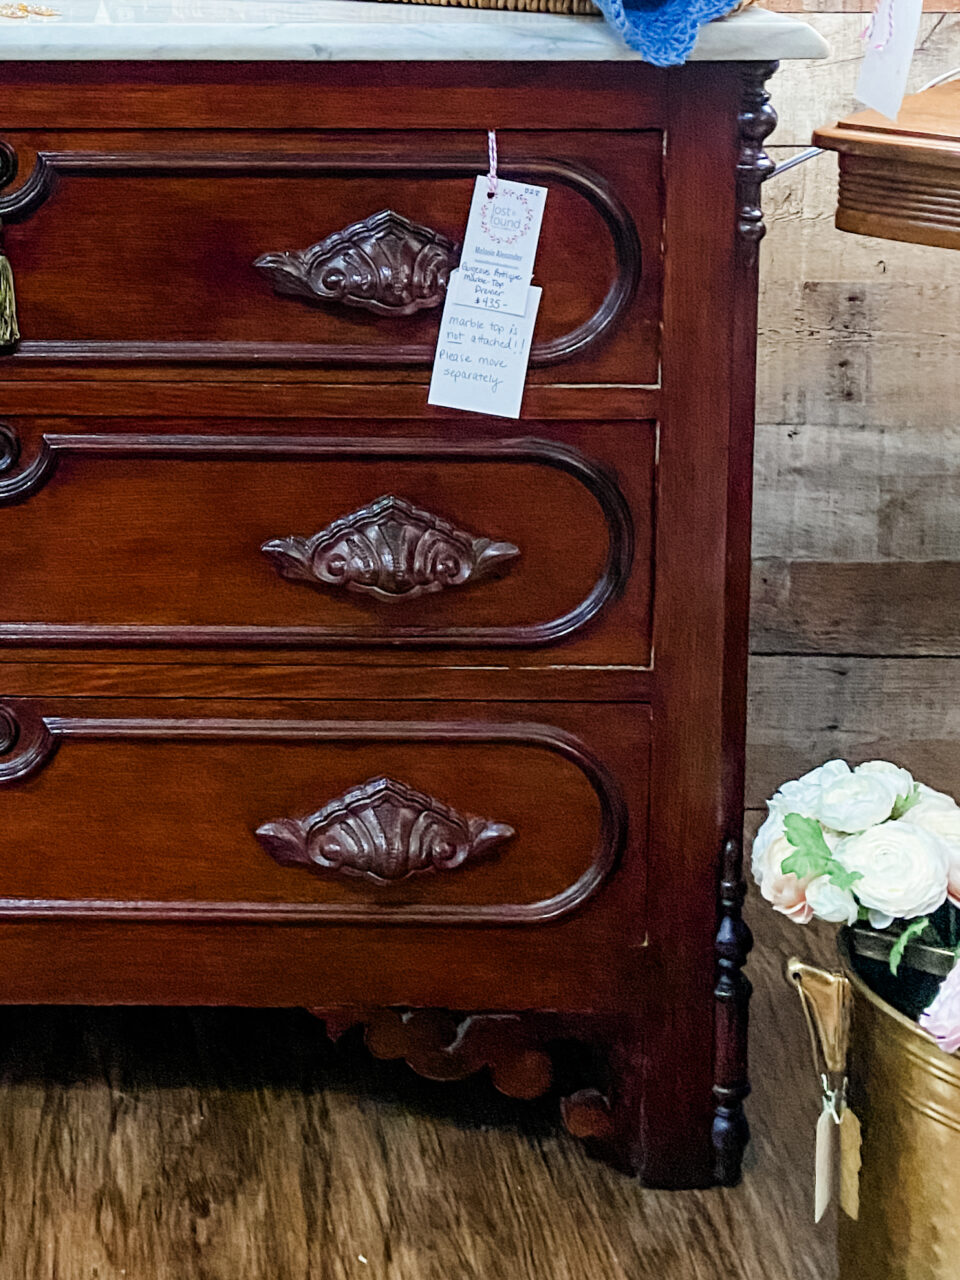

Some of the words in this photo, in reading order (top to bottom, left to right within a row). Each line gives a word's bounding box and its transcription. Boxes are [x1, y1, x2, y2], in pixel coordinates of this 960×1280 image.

[448, 316, 484, 329] marble
[490, 323, 505, 335] top
[509, 323, 518, 335] is
[446, 331, 464, 341] not
[471, 334, 525, 355] attached!!
[478, 356, 508, 368] move
[443, 368, 504, 394] separately
